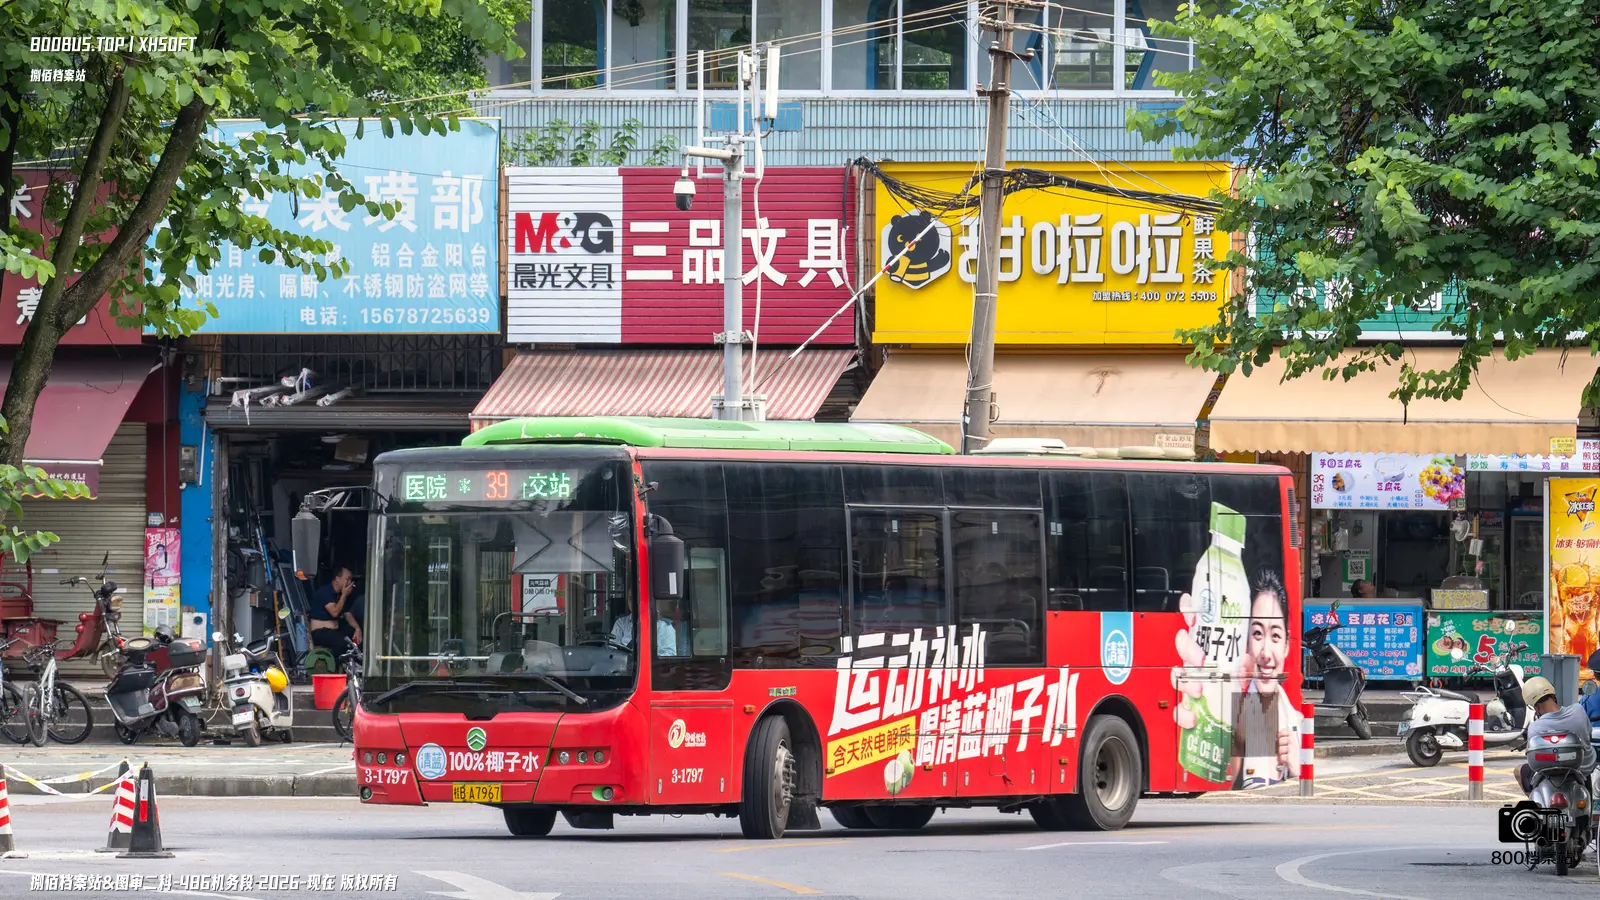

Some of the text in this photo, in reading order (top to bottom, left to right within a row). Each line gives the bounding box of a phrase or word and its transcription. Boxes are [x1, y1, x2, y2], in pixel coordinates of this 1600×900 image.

[514, 211, 615, 254] M&G
[625, 216, 846, 288] 三品文具
[1192, 215, 1216, 285] 鲜果茶
[514, 263, 615, 289] 晨光文具
[1164, 291, 1186, 302] 072
[1189, 291, 1217, 302] 5508
[1320, 458, 1362, 468] 芋圆豆腐花
[1470, 460, 1489, 469] 炒饭
[406, 474, 447, 500] 医院
[486, 472, 508, 499] 39
[522, 472, 571, 498] 交站
[1376, 482, 1402, 491] 豆腐花
[1348, 613, 1390, 625] 豆腐花
[827, 623, 987, 736] 运动补水
[915, 664, 1081, 767] 喝清蓝椰子水
[831, 722, 912, 768] 含天然电解质
[365, 768, 409, 786] 3-1797
[671, 768, 704, 784] 3-1797
